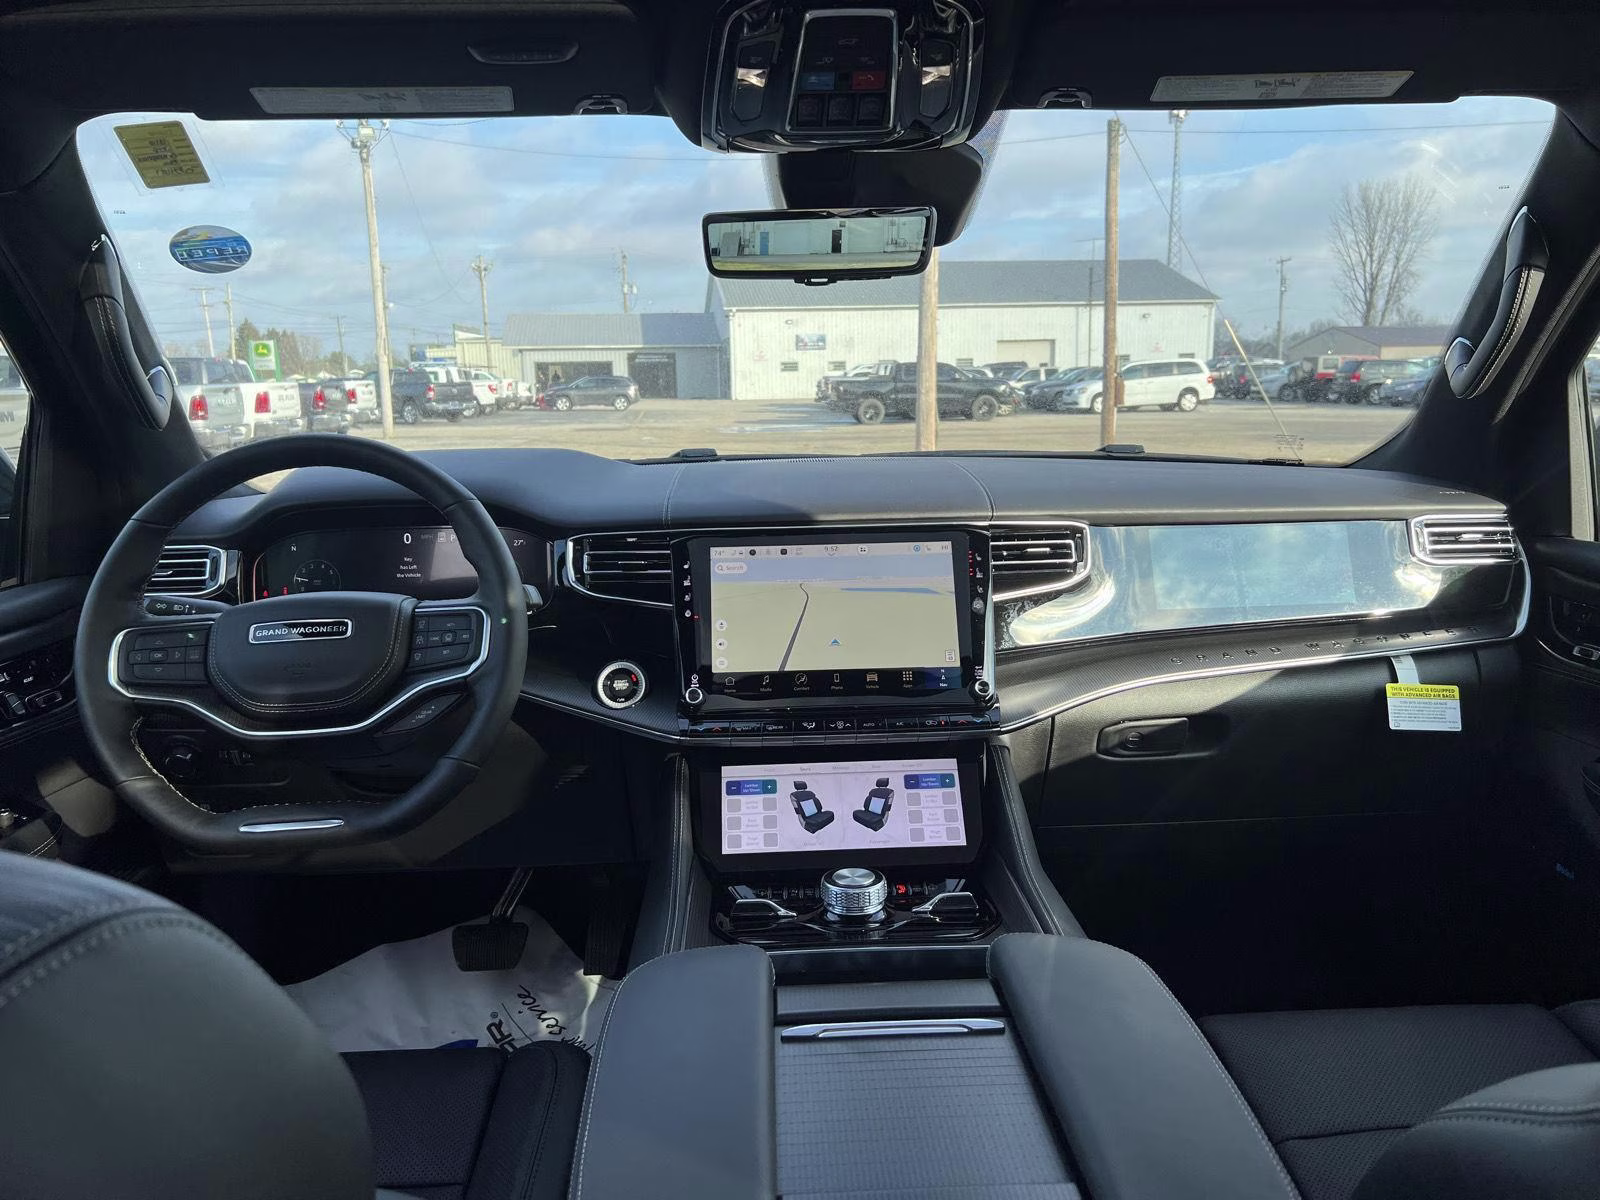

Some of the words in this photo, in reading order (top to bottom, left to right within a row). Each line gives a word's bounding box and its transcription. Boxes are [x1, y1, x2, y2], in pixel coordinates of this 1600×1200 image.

[403, 533, 412, 544] 0
[255, 628, 289, 637] GRAND
[290, 626, 346, 634] WAGONEER
[1170, 647, 1281, 664] GRAND
[517, 984, 567, 1035] service
